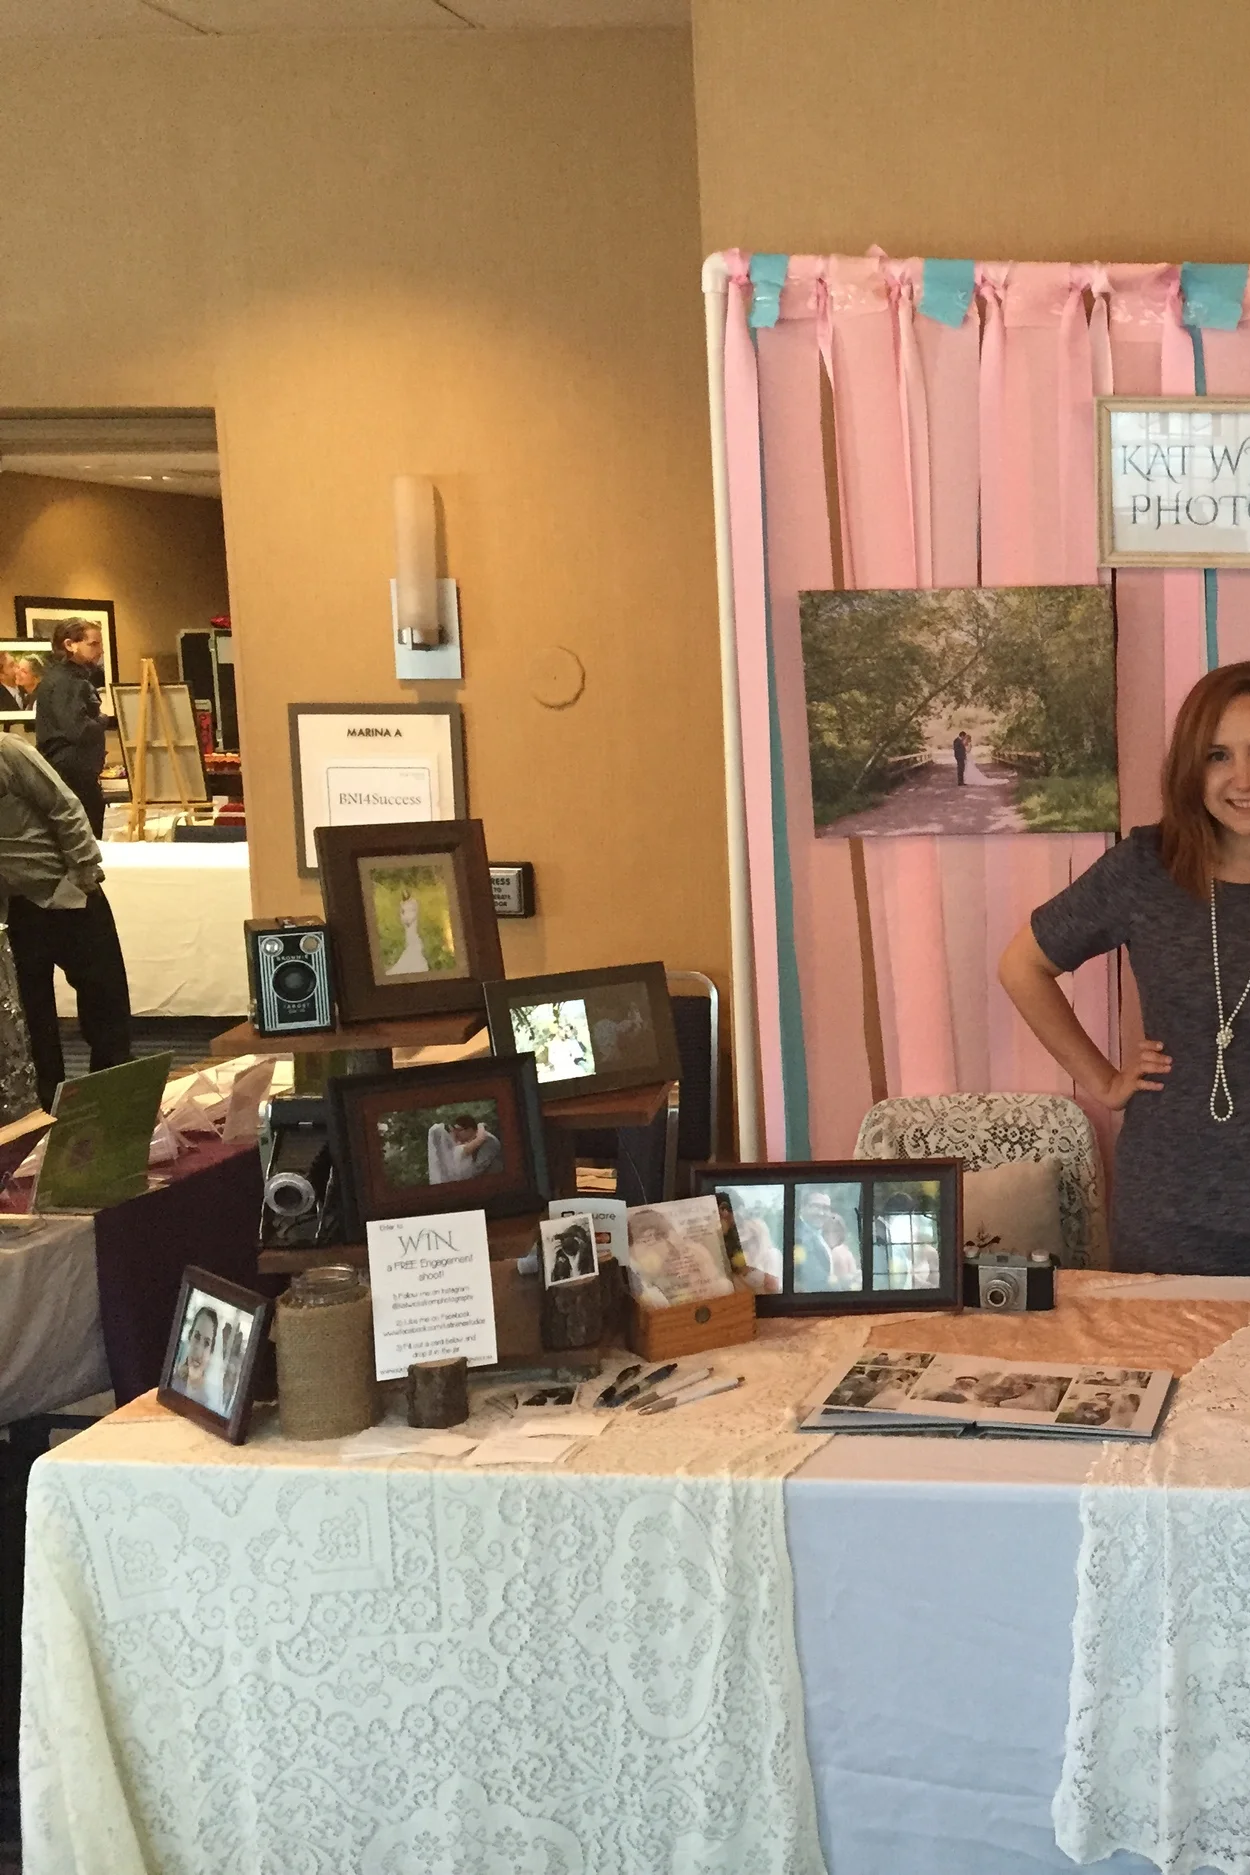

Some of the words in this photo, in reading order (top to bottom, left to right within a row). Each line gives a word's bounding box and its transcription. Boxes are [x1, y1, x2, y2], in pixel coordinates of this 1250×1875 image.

[1121, 443, 1194, 484] KAT
[346, 728, 391, 738] MARINA
[394, 728, 402, 738] A
[338, 792, 422, 806] BNI4Success
[491, 877, 511, 886] RESS
[397, 1227, 460, 1258] WIN
[386, 1264, 393, 1272] a
[394, 1259, 418, 1271] FREE
[420, 1254, 474, 1270] Engagement
